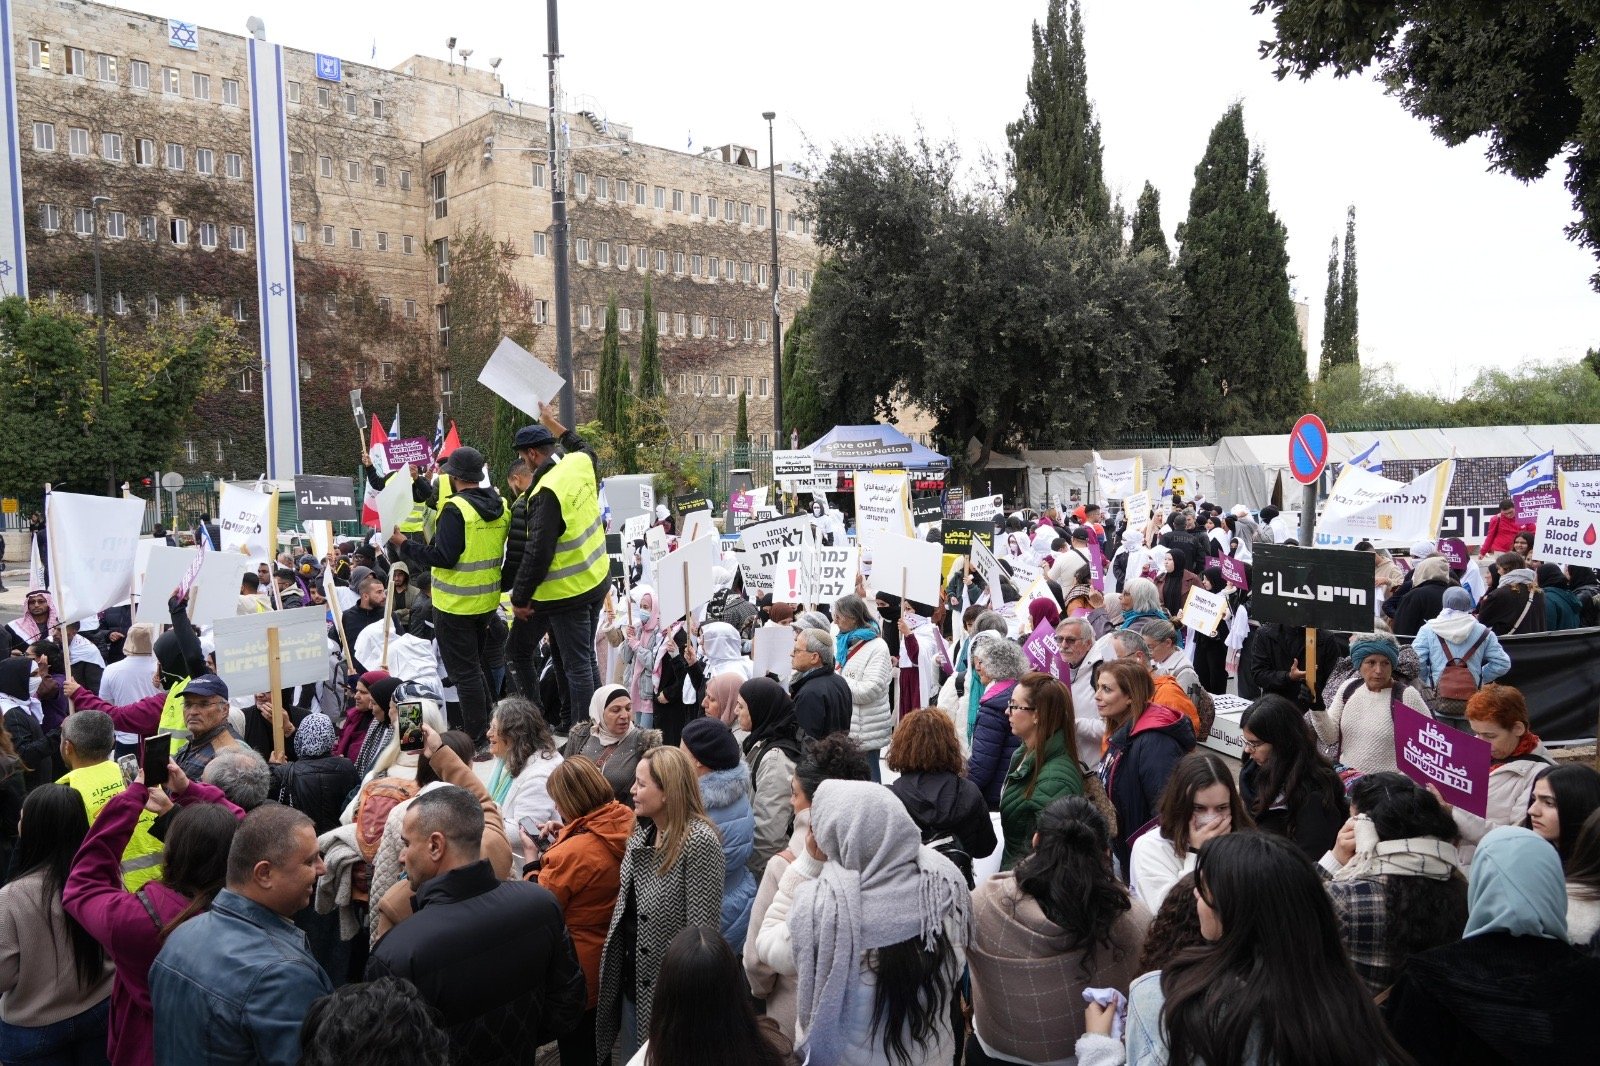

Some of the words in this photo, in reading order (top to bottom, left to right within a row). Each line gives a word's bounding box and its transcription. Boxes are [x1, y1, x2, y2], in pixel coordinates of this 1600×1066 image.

[826, 442, 854, 452] Save
[857, 440, 877, 449] our
[836, 449, 872, 457] Startup
[874, 446, 909, 454] Nation
[828, 461, 864, 471] Startup
[864, 461, 899, 469] Nation
[301, 490, 330, 510] حياة
[330, 495, 352, 506] חיים
[1377, 494, 1409, 504] להיו
[1412, 493, 1427, 504] לא
[1547, 515, 1580, 528] Arabs
[766, 526, 789, 538] אנחנו
[781, 528, 803, 547] לא
[1545, 529, 1578, 542] Blood
[752, 537, 781, 549] אזרחים
[1542, 543, 1593, 559] Matters
[1260, 570, 1316, 607] حياة
[1317, 584, 1367, 606] חיים
[1421, 733, 1449, 754] ביחד
[1406, 737, 1444, 768] الجريمة
[1405, 750, 1446, 782] הפשיעה
[1445, 762, 1468, 776] ضد
[1448, 774, 1469, 790] נגד
